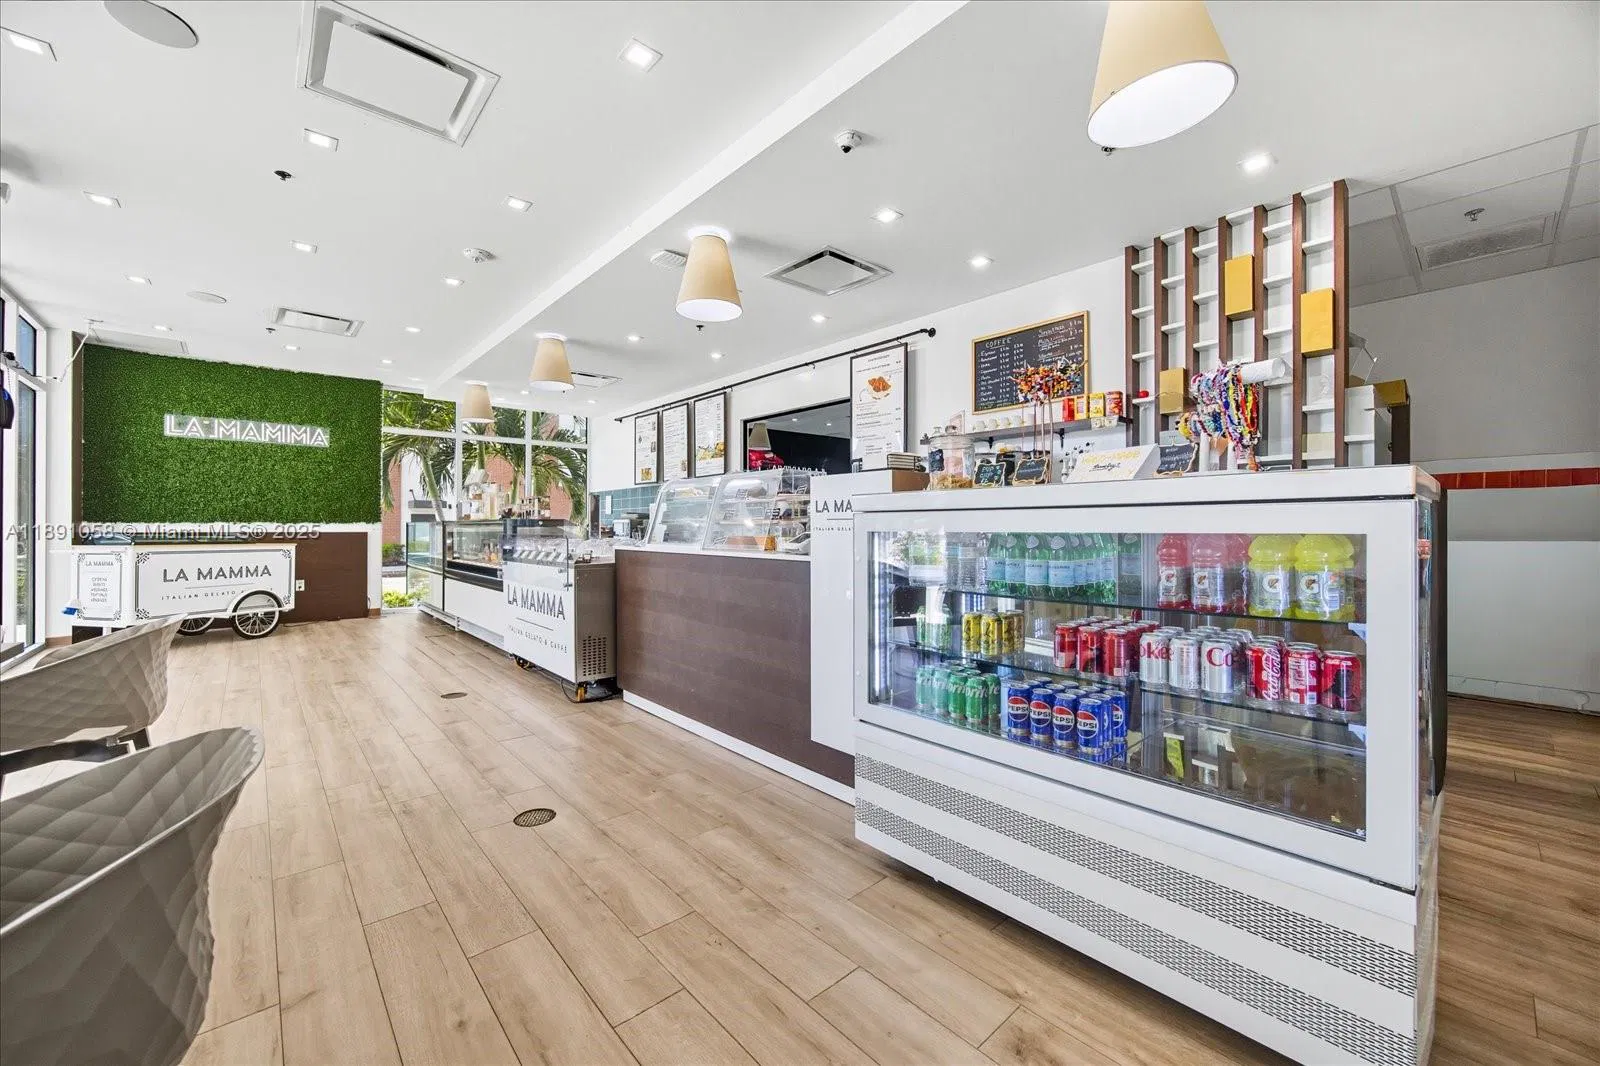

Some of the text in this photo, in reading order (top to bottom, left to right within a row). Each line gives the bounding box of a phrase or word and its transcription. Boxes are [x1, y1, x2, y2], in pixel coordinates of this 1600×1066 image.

[985, 337, 1012, 348] COFFEE
[166, 415, 329, 447] LA MAMMA
[815, 500, 830, 513] LA
[163, 565, 272, 582] LA MAMMA
[507, 584, 566, 620] LA MAMMA
